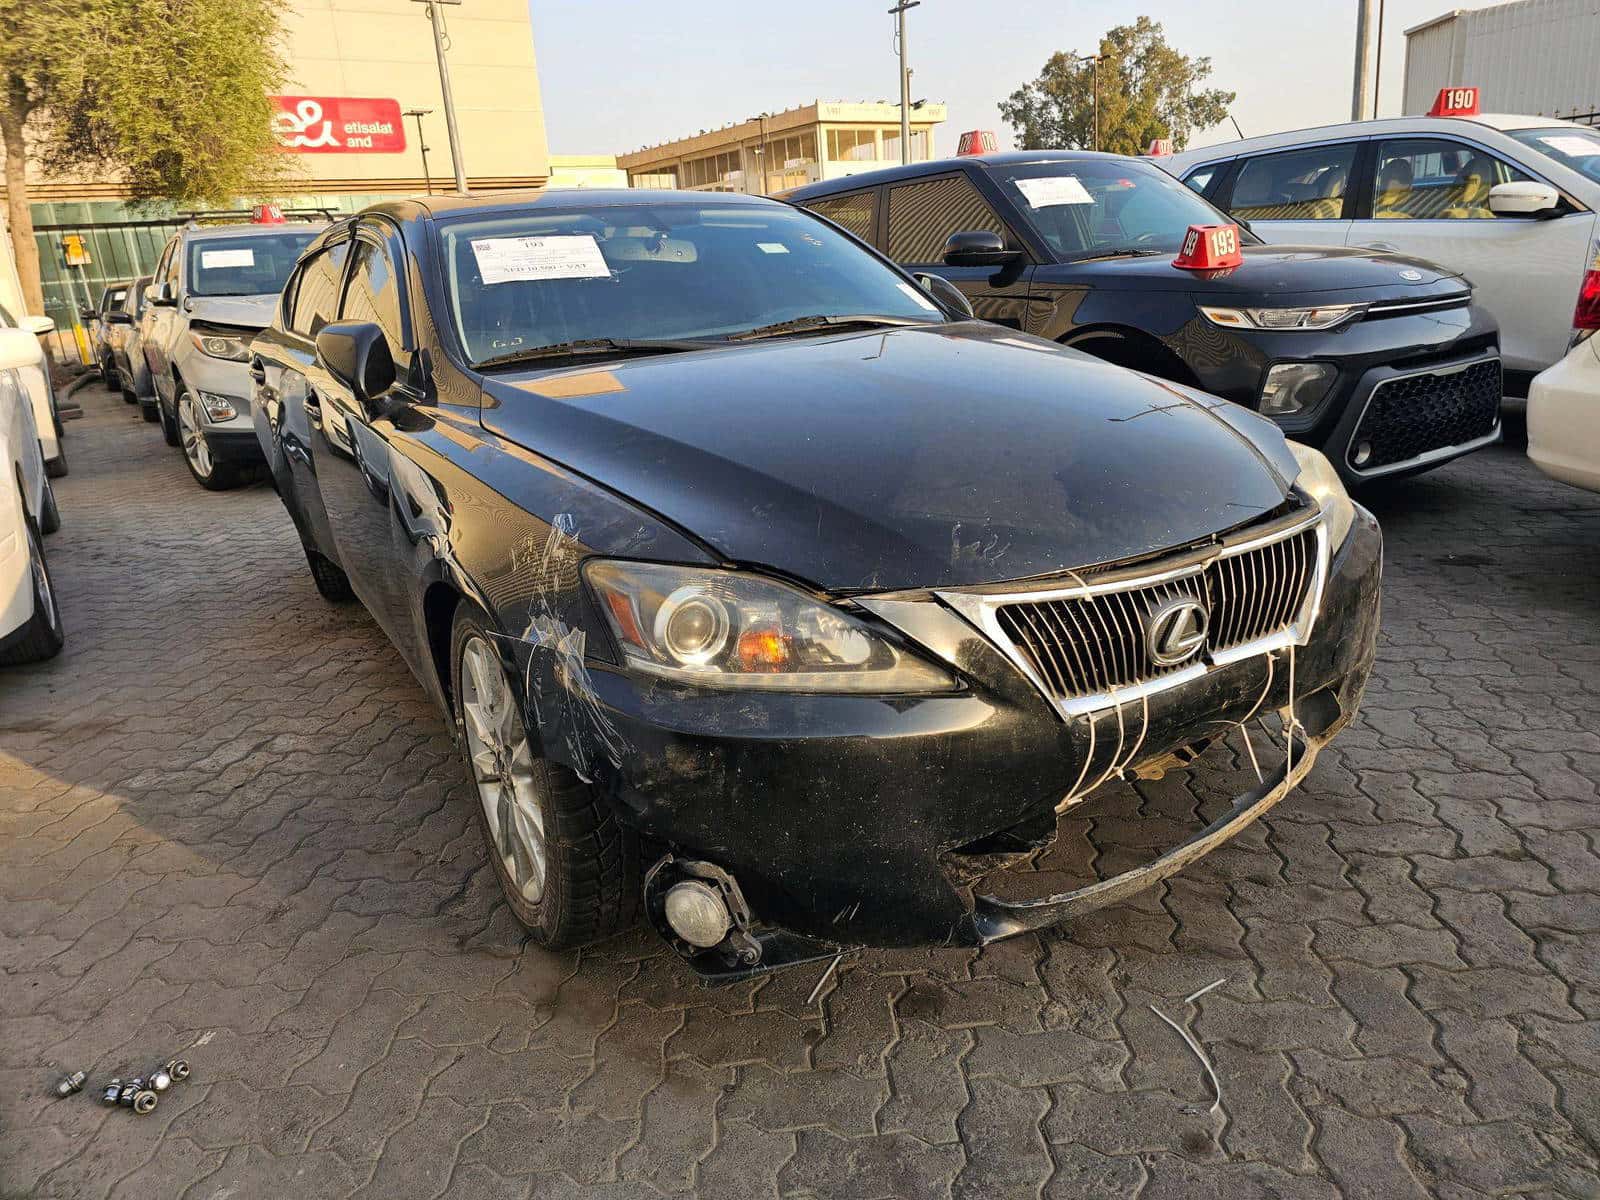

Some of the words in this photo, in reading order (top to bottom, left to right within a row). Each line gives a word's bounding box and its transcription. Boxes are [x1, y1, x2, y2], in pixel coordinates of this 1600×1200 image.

[1447, 89, 1474, 110] 190
[344, 121, 393, 135] etisalat
[346, 135, 373, 148] and
[1183, 230, 1199, 257] 193
[1211, 229, 1236, 257] 193
